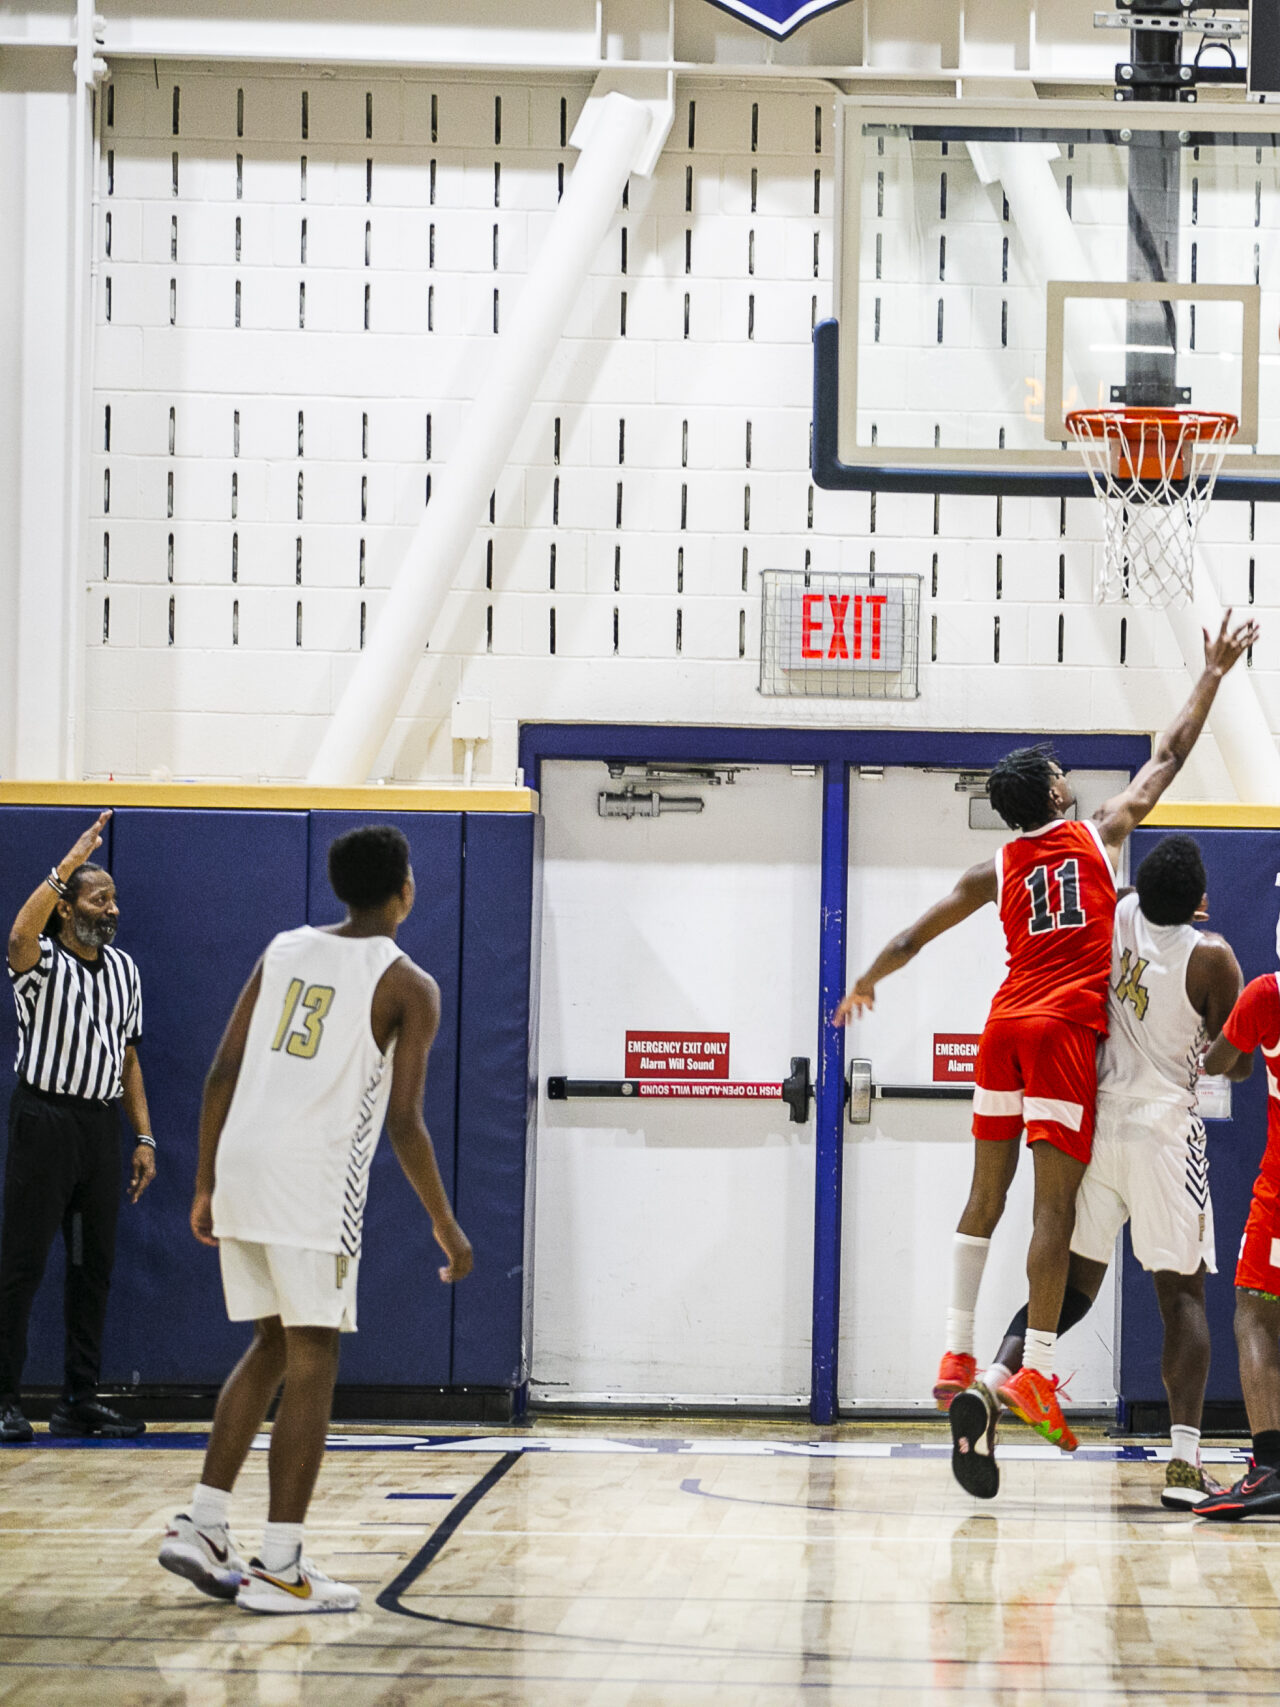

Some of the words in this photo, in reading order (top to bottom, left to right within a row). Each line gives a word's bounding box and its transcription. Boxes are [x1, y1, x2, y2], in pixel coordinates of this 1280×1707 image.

[801, 594, 888, 660] EXIT
[1024, 858, 1086, 935] 11
[271, 977, 336, 1060] 13
[628, 1040, 681, 1054] EMERGENCY
[683, 1042, 702, 1054] EXIT
[704, 1042, 727, 1055] ONLY
[640, 1057, 666, 1069] Alarm
[668, 1057, 685, 1070] Will
[687, 1058, 715, 1071] Sound
[948, 1060, 974, 1072] Alarm
[641, 1084, 669, 1095] SOUND
[671, 1085, 690, 1095] WILL
[747, 1086, 758, 1096] TO
[759, 1085, 781, 1096] PUSH
